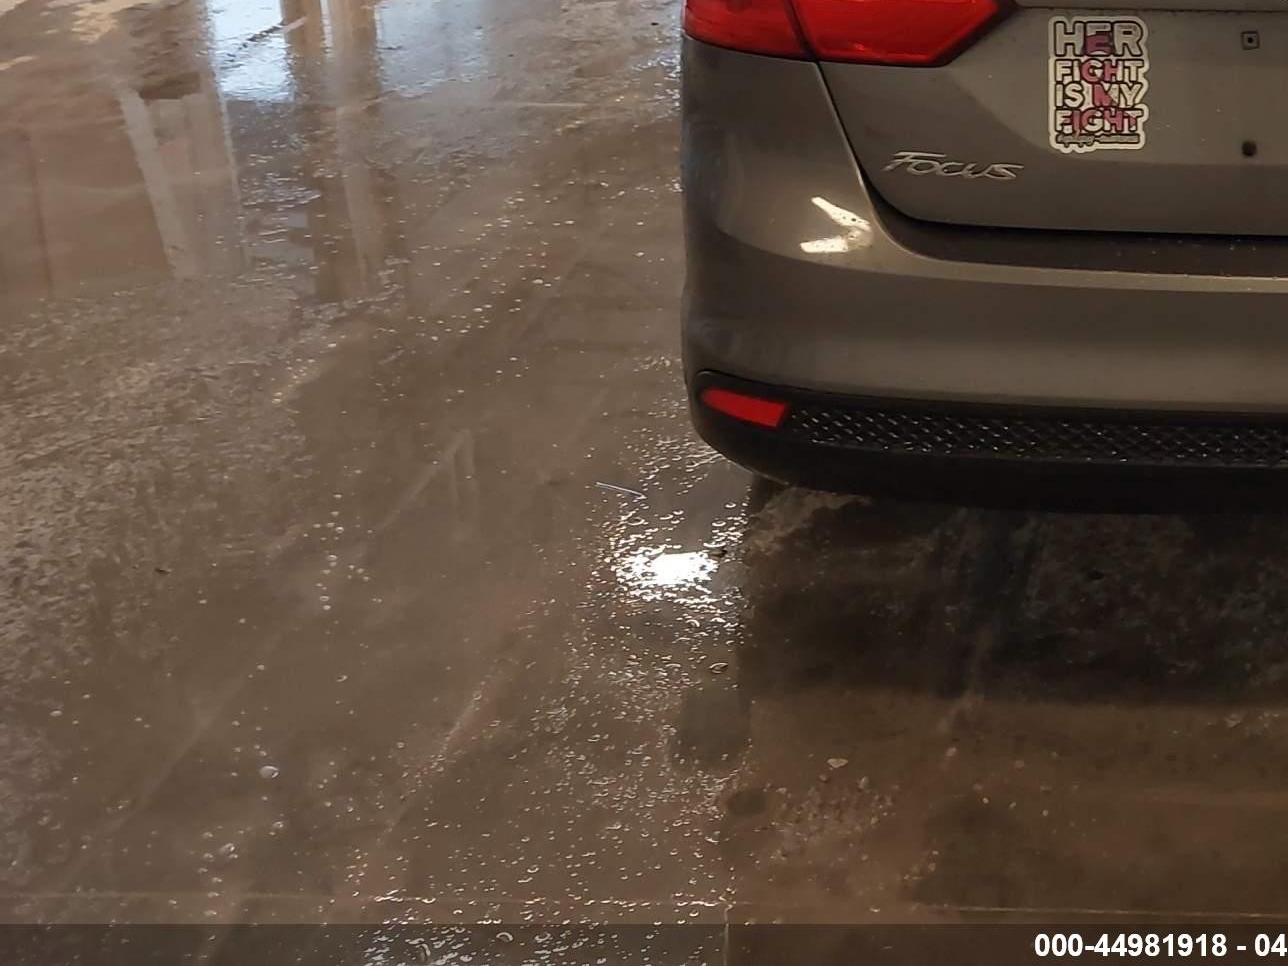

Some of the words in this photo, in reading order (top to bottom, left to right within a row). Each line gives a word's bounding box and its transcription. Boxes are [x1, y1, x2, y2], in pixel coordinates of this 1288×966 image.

[1054, 20, 1143, 57] HER
[1055, 58, 1144, 83] FIGHT
[1055, 82, 1084, 108] IS
[1092, 82, 1143, 108] MY
[1055, 108, 1144, 133] FIGHT
